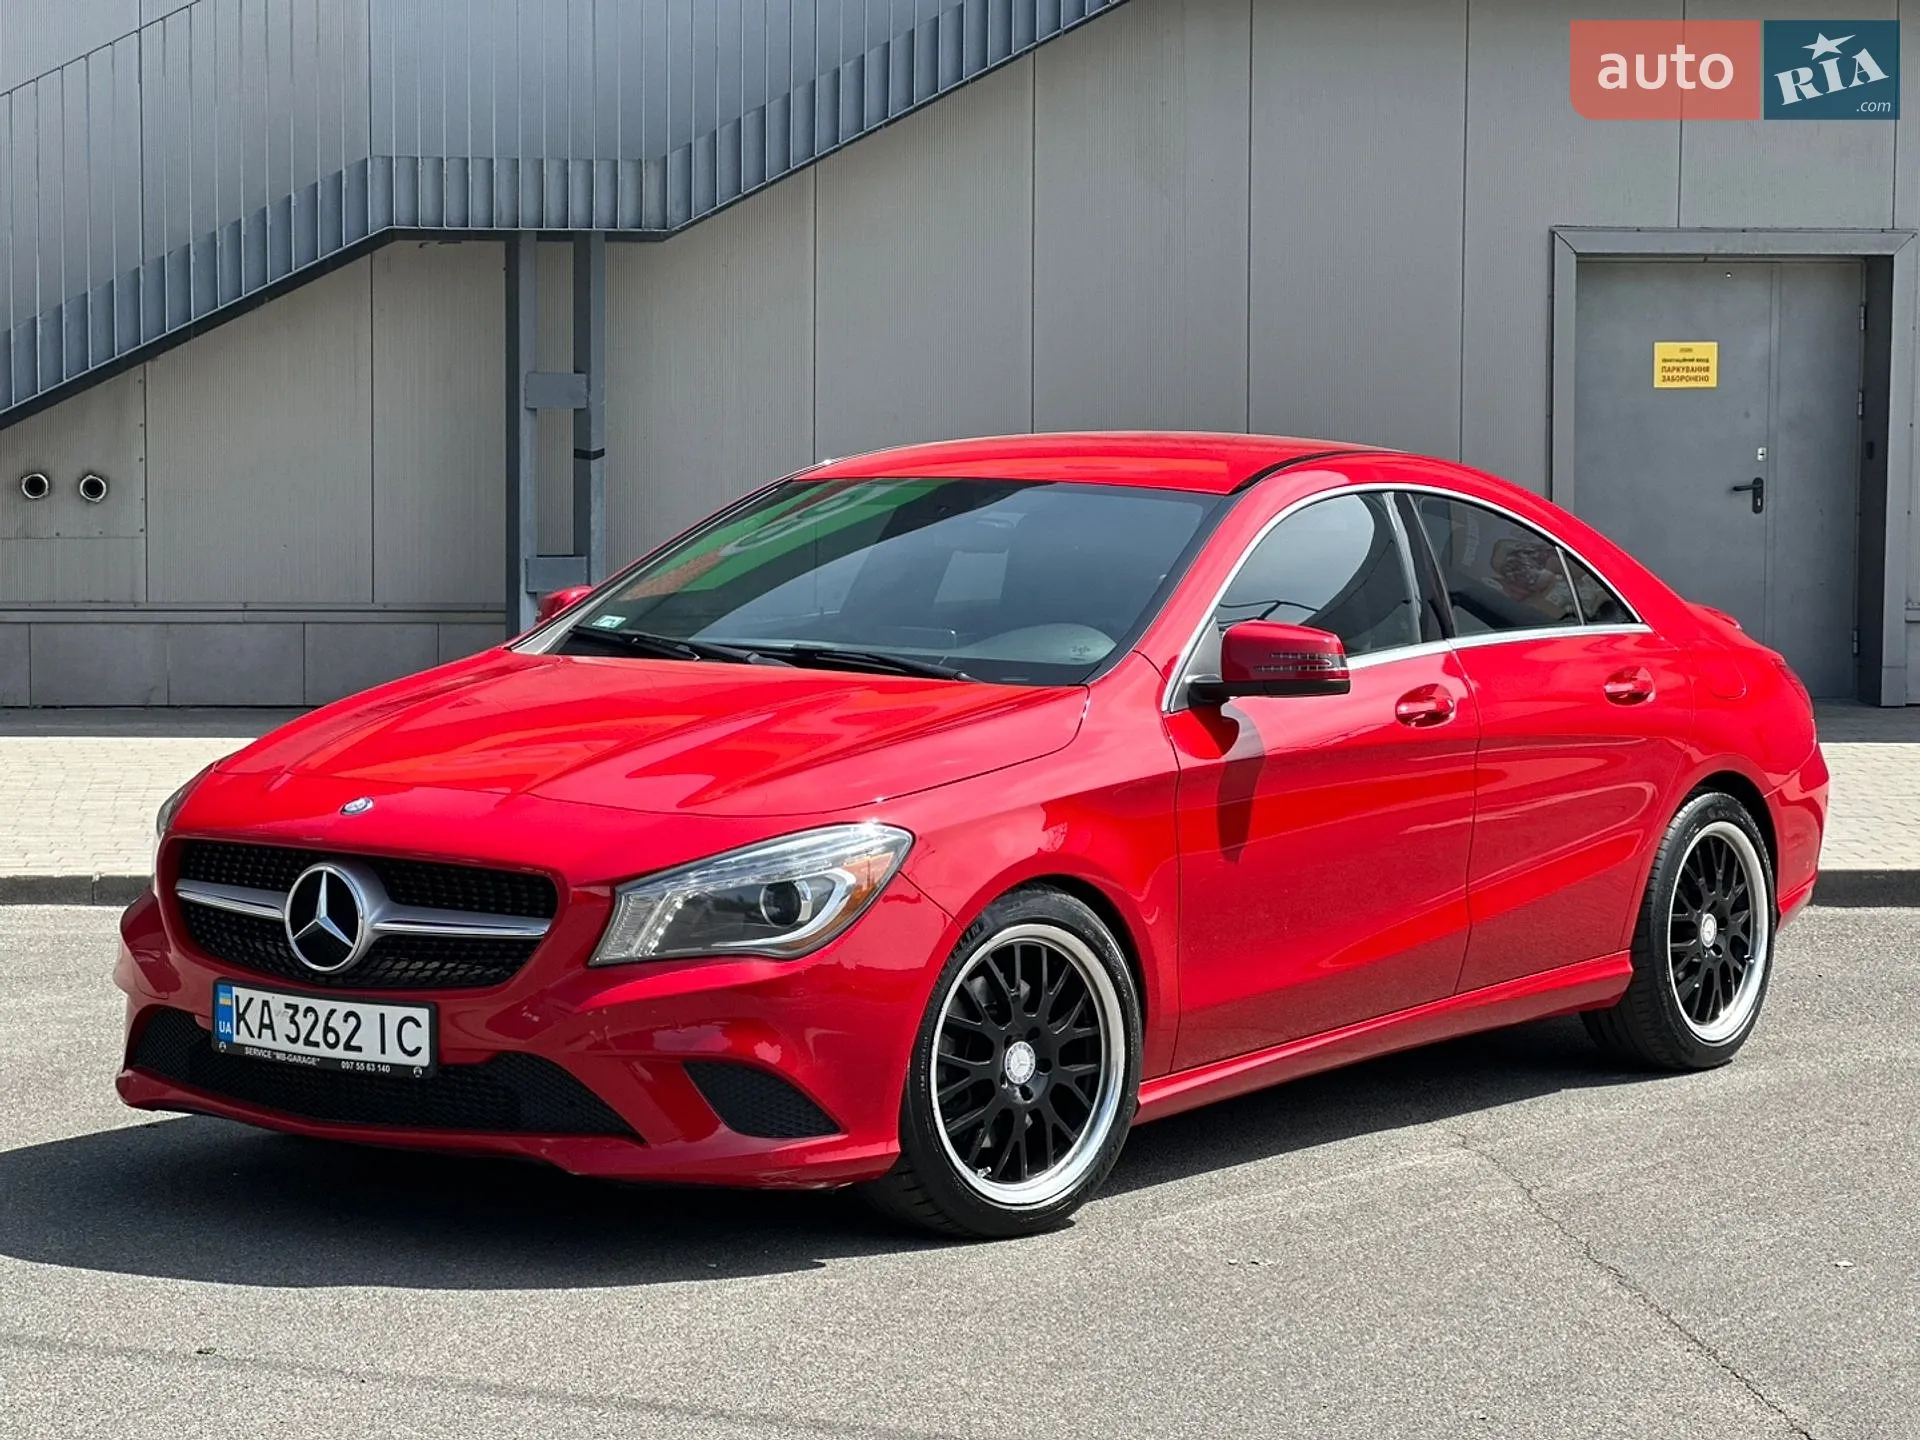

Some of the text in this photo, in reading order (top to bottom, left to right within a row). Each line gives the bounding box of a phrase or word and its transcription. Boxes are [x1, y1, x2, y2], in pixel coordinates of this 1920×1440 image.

[1661, 365, 1710, 373] ПАРКУВАННЯ
[1661, 375, 1709, 383] ЗАБОРОНЕНО
[218, 1021, 232, 1034] UA
[234, 994, 423, 1058] KA 3262 IC
[244, 1046, 272, 1059] SERVICE
[340, 1060, 354, 1070] 097
[355, 1062, 365, 1071] 55
[377, 1063, 391, 1073] 140
